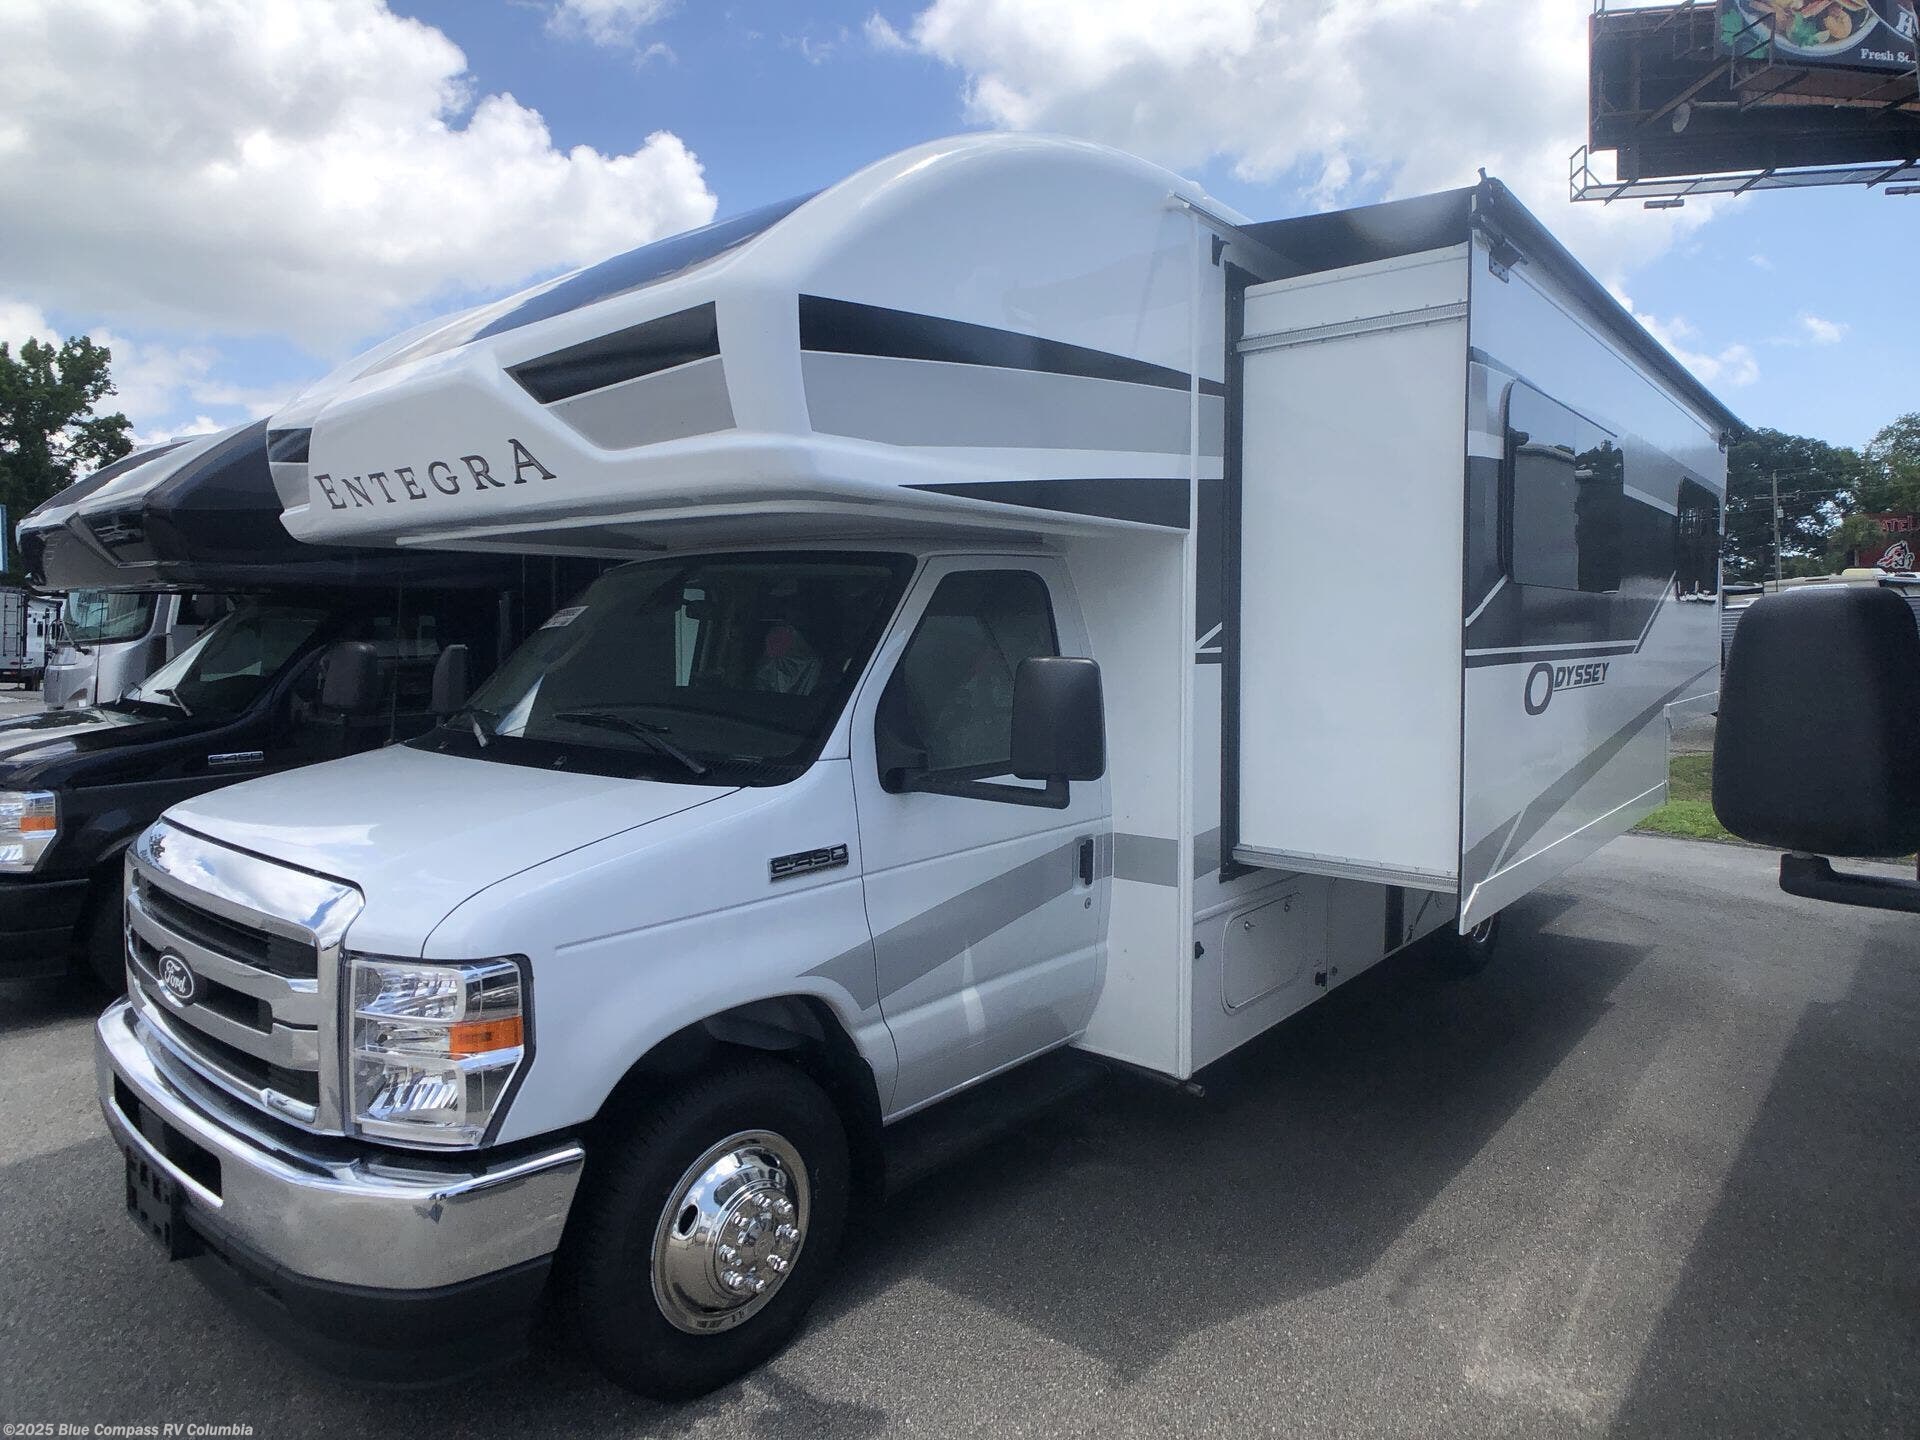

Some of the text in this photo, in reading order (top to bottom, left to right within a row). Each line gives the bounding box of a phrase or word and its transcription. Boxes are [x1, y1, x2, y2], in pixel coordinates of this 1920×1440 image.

[1860, 48, 1894, 61] Fresh
[314, 438, 557, 510] ENTEGRA
[1524, 662, 1610, 715] ODYSSEY
[164, 960, 187, 994] Ford
